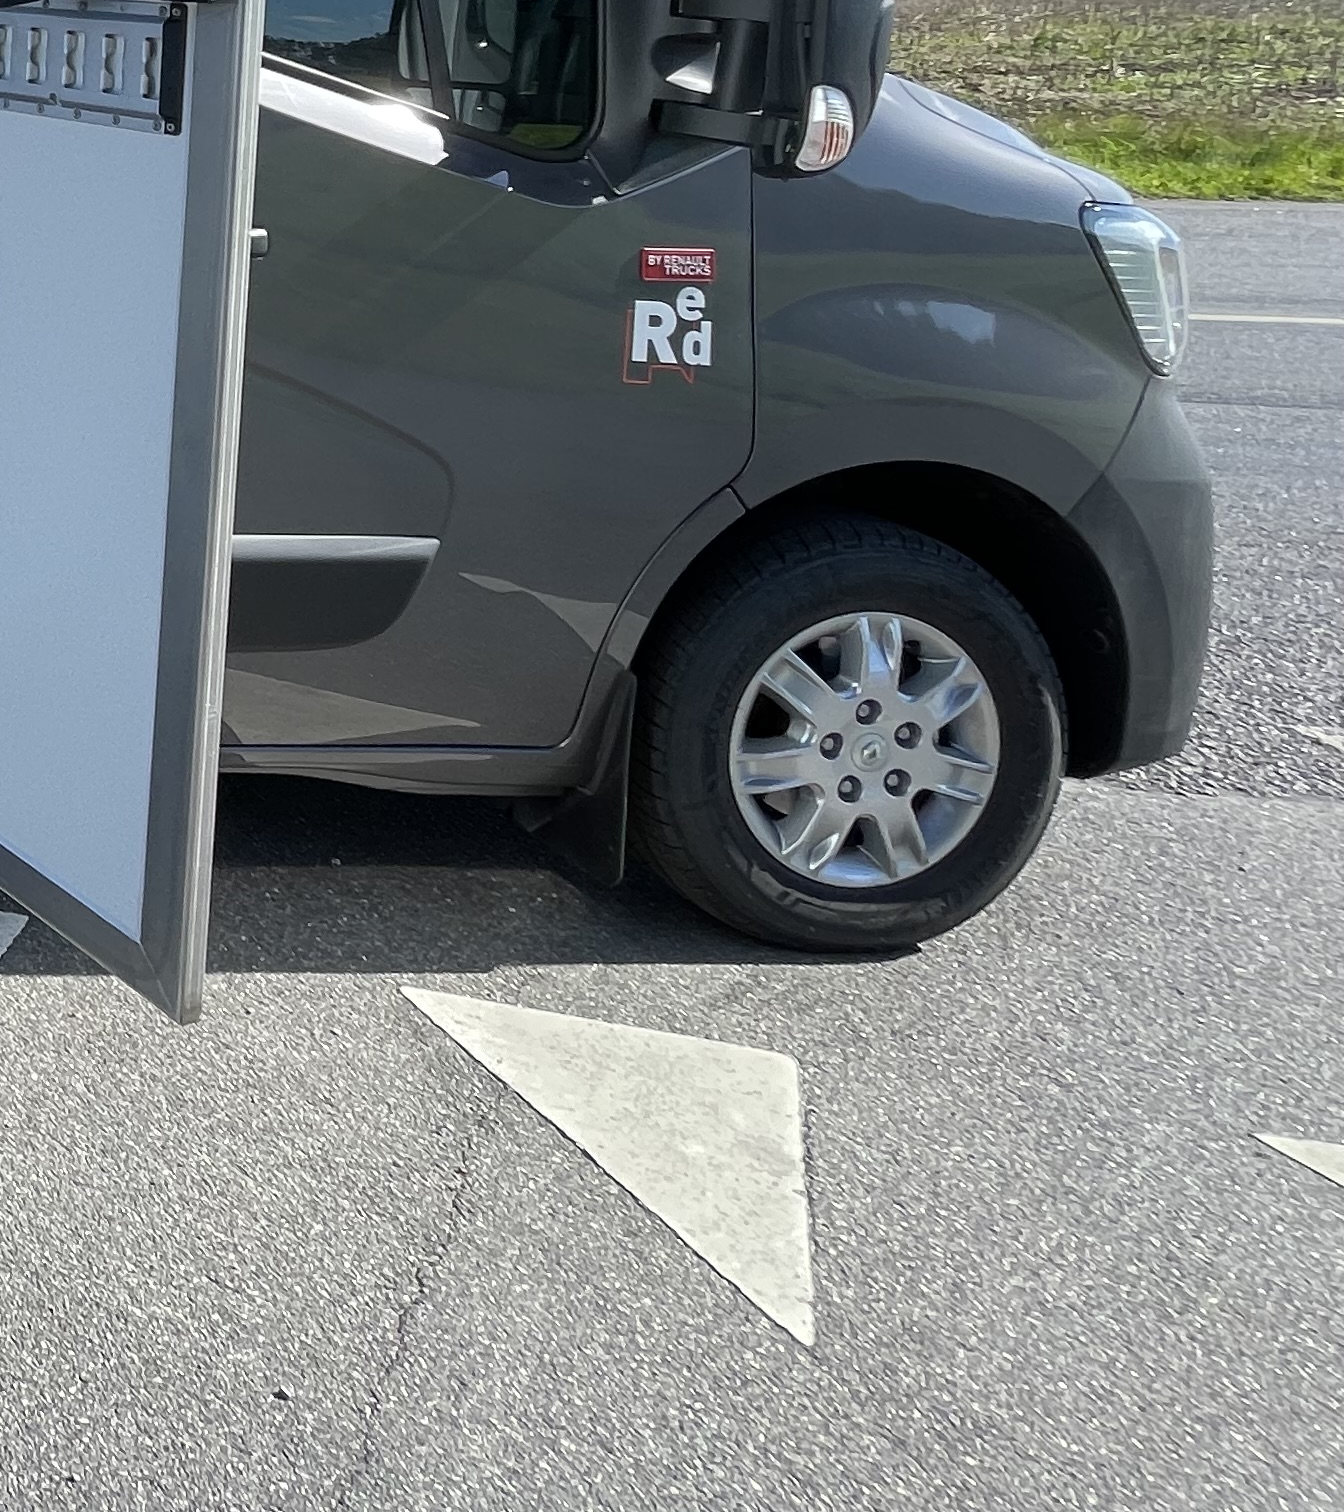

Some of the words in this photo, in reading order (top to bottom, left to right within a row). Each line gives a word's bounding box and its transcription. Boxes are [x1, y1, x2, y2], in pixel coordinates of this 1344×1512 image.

[648, 255, 662, 265] BY
[663, 255, 711, 265] RENAULT
[664, 265, 711, 276] TRUCKS
